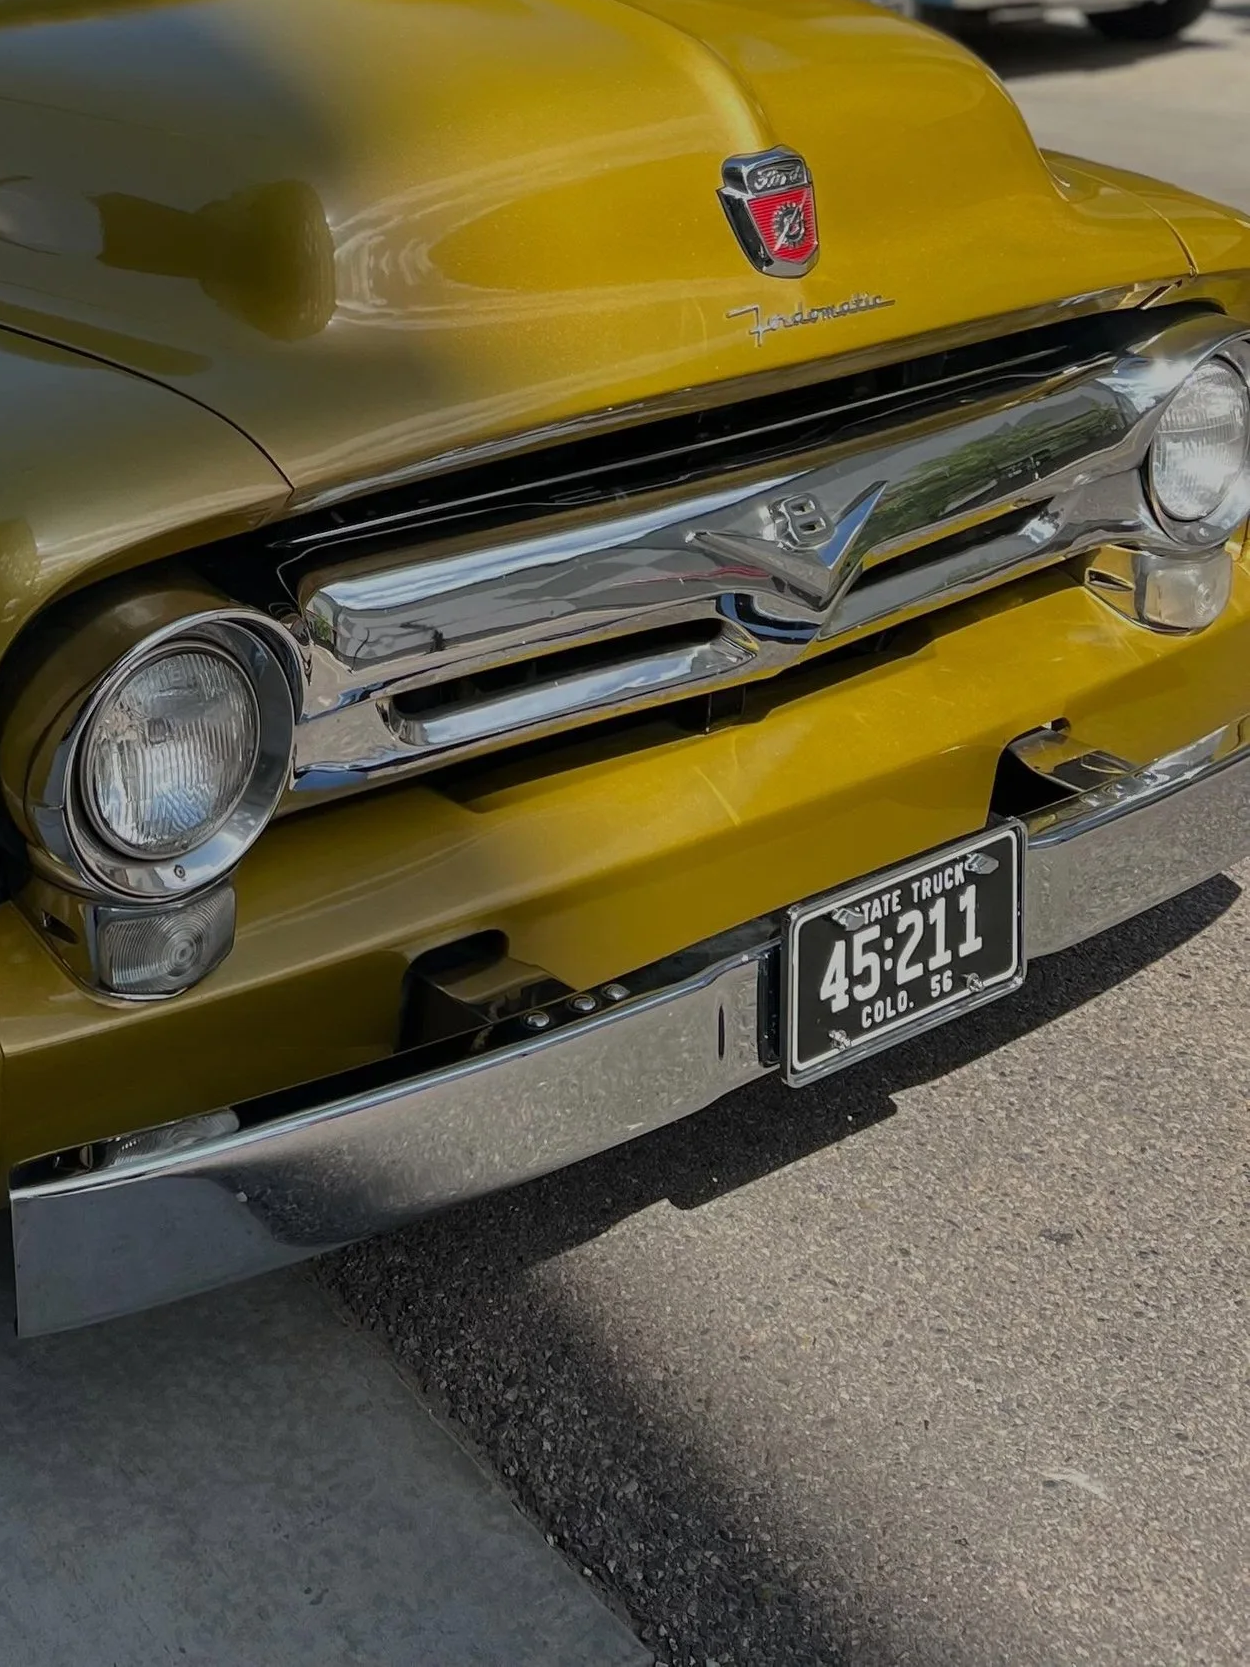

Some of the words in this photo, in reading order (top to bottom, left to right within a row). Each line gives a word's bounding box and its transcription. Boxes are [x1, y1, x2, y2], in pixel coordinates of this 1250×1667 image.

[754, 165, 802, 190] Ford
[725, 290, 896, 348] Fordomatic
[855, 889, 903, 925] TATE
[911, 860, 966, 903] TRUCK
[860, 989, 915, 1029] COLO.
[929, 970, 953, 998] 56
